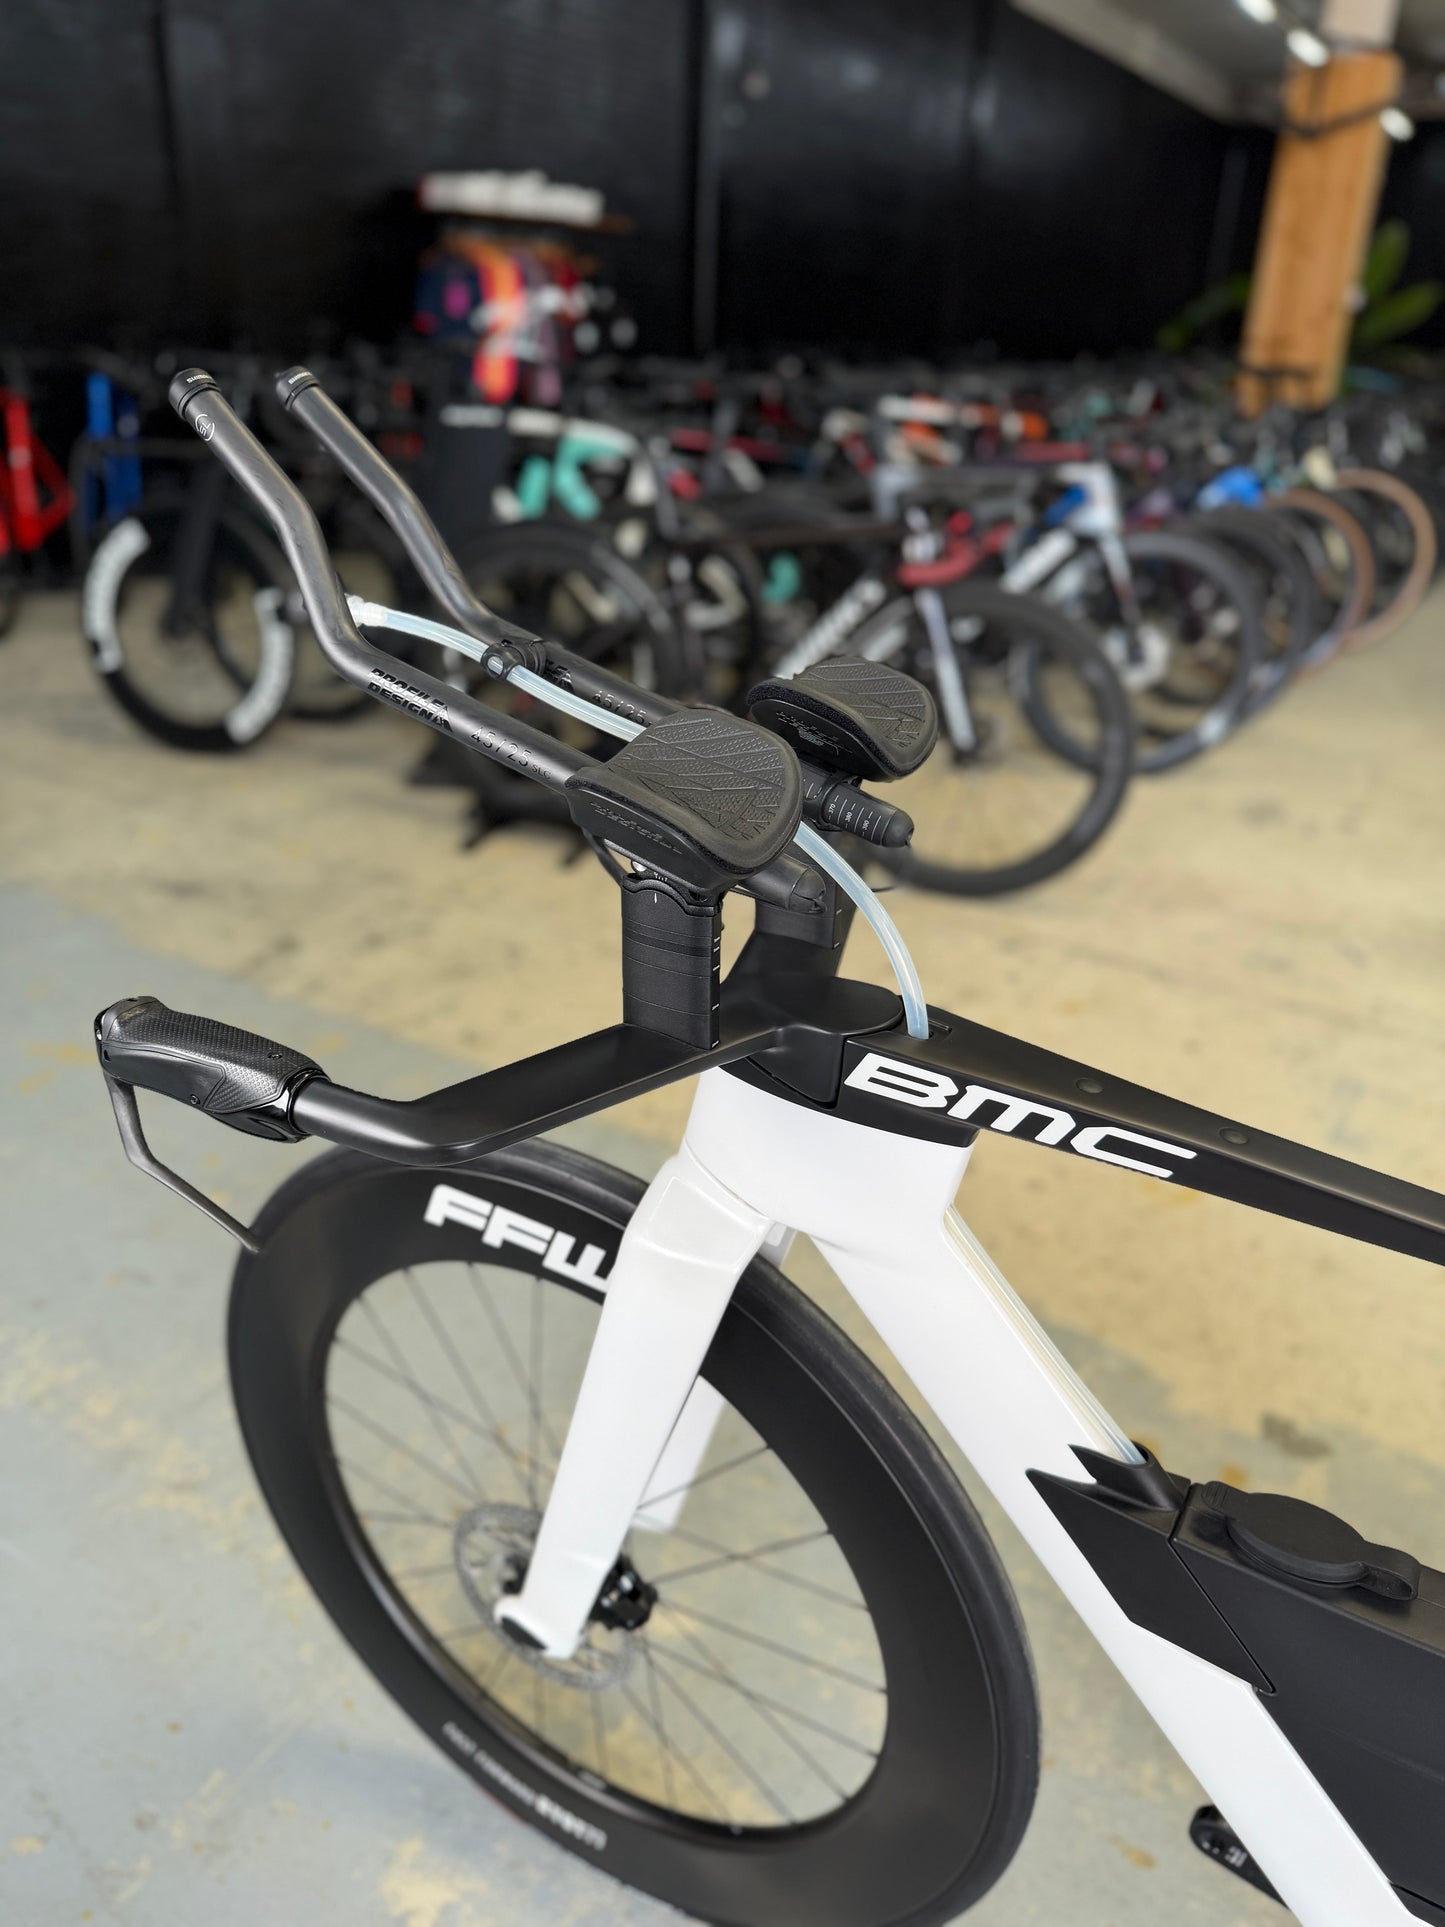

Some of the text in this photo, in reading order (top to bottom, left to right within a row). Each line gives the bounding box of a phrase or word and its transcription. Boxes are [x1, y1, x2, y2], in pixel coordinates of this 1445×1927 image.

[367, 667, 446, 713] PROFILE
[367, 681, 434, 721] DESIGN
[471, 726, 532, 767] 45/25
[844, 1052, 1197, 1179] BMC
